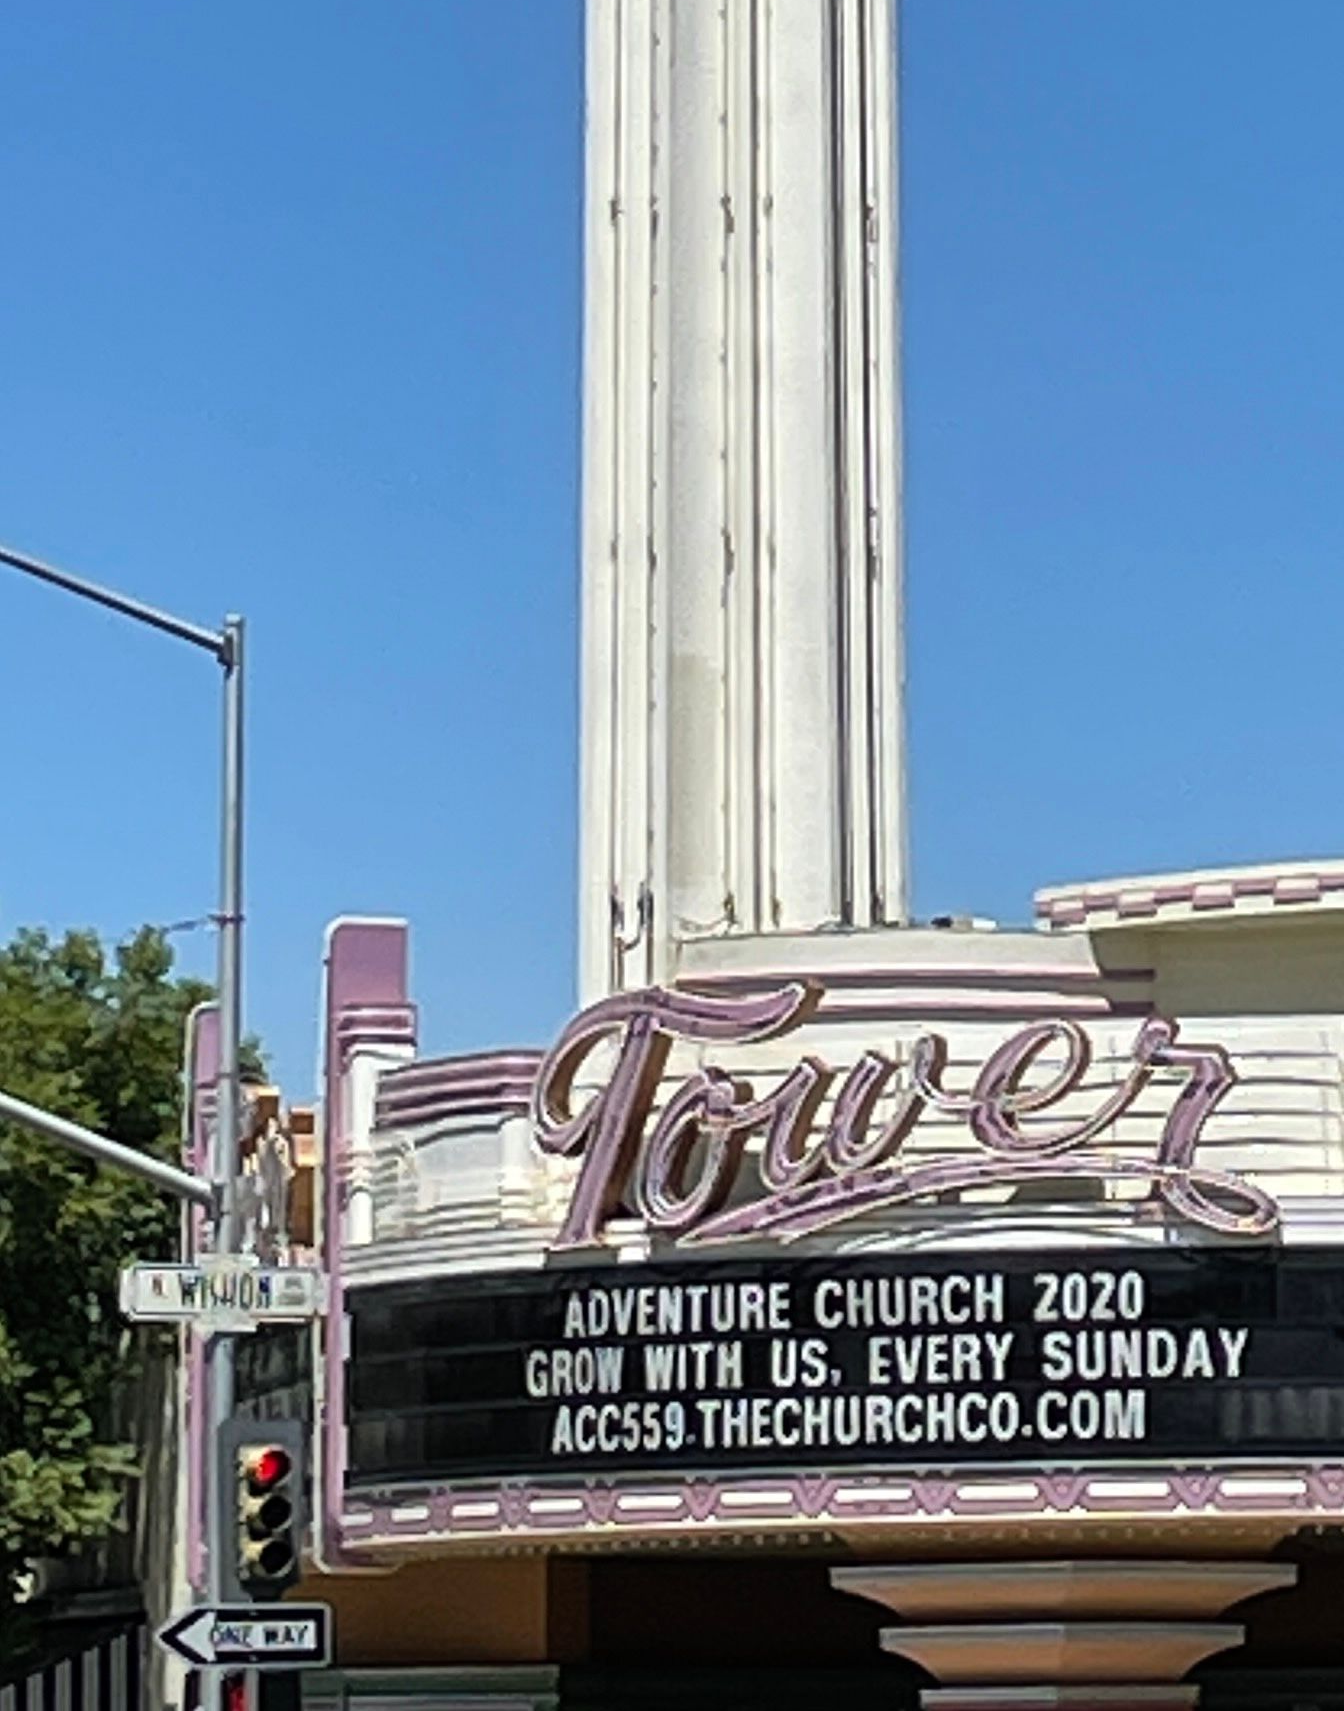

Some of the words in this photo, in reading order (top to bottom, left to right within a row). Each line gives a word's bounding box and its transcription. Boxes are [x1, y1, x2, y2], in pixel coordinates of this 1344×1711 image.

[529, 983, 1280, 1251] Tower
[563, 1282, 792, 1338] ADVENTURE
[814, 1274, 1005, 1329] CHURCH
[1034, 1270, 1145, 1323] 2020
[525, 1346, 625, 1397] GROW
[644, 1340, 743, 1392] WITH
[771, 1339, 842, 1388] US,
[868, 1332, 1014, 1385] EVERY
[1041, 1327, 1250, 1380] SUNDAY
[551, 1388, 1147, 1455] ACC559.THECHURCHCO.COM
[209, 1623, 253, 1648] ONE
[262, 1623, 309, 1647] WAY
